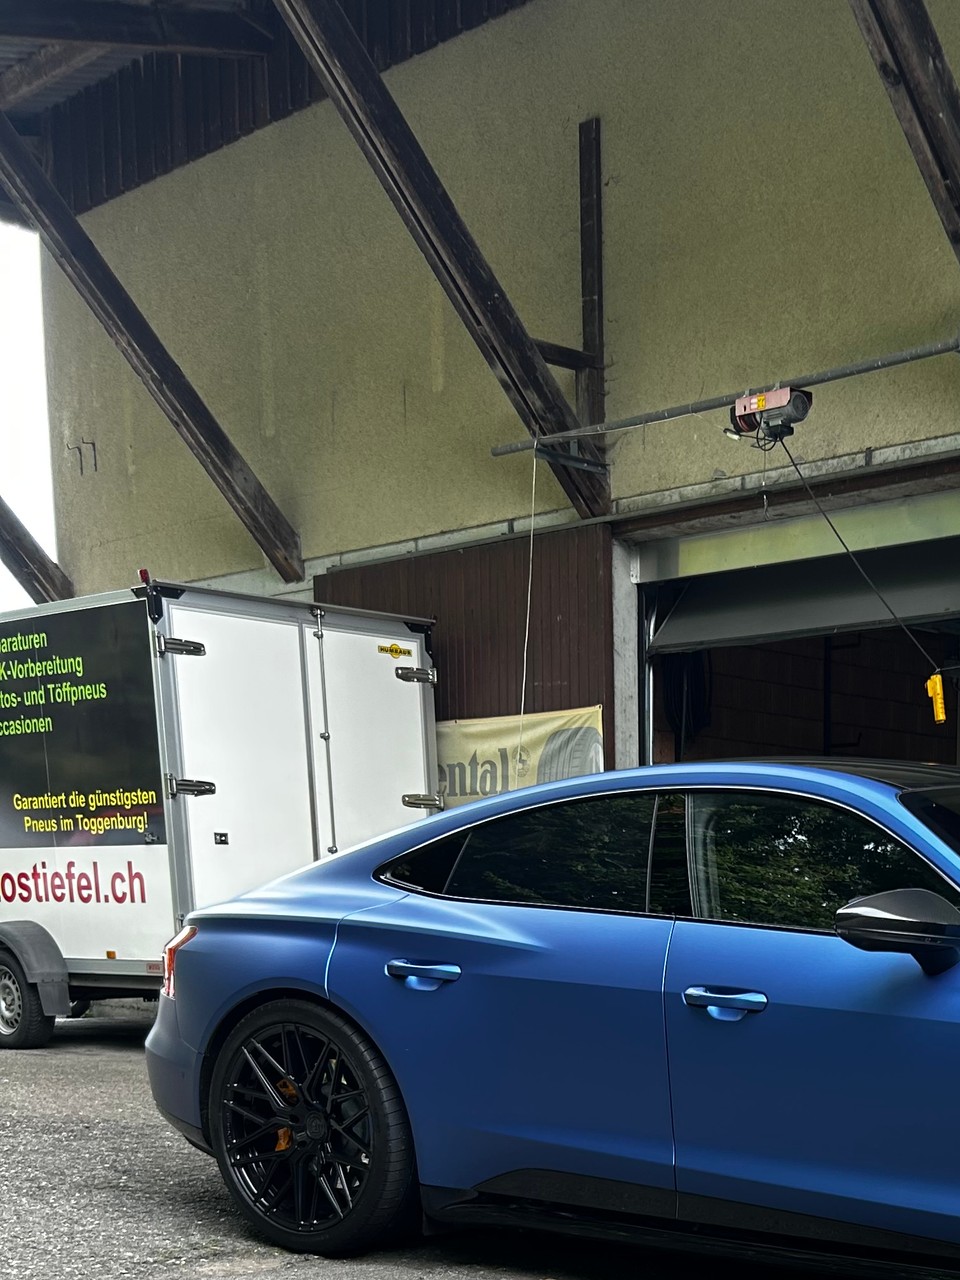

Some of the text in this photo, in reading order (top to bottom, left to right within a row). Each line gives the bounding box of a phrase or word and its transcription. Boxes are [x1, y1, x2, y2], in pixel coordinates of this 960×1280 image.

[0, 632, 48, 653] araturen
[24, 686, 46, 706] und
[47, 682, 107, 706] Töffpneus
[13, 788, 157, 811] Garantiert die günstigsten
[24, 811, 148, 834] Pneus im Toggenburg!
[0, 861, 147, 904] ostiefel.ch
